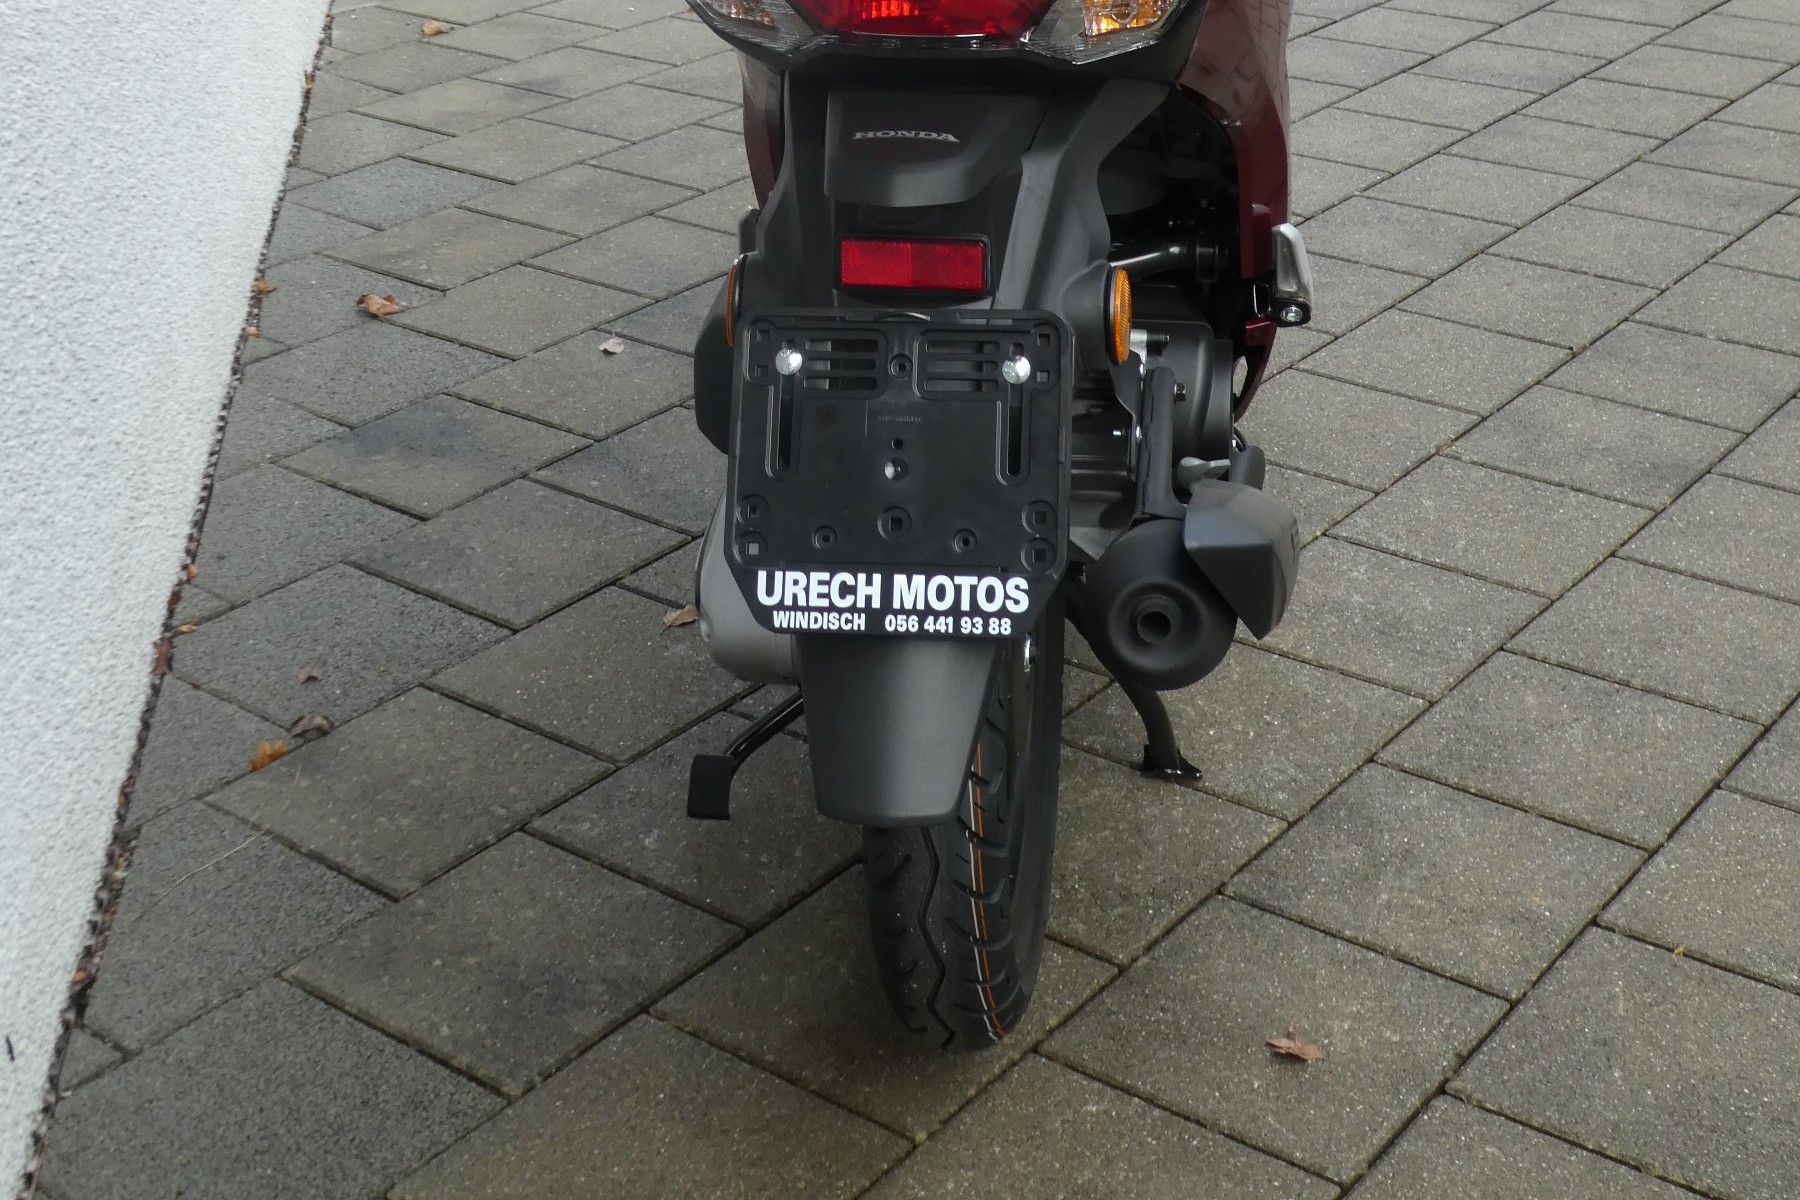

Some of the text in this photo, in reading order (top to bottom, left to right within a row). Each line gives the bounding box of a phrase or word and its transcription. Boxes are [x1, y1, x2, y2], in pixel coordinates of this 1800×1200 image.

[852, 130, 960, 143] HONDA
[757, 570, 1030, 614] URECH MOTOS
[772, 610, 1012, 635] WINDISCH 056 441 93 88
